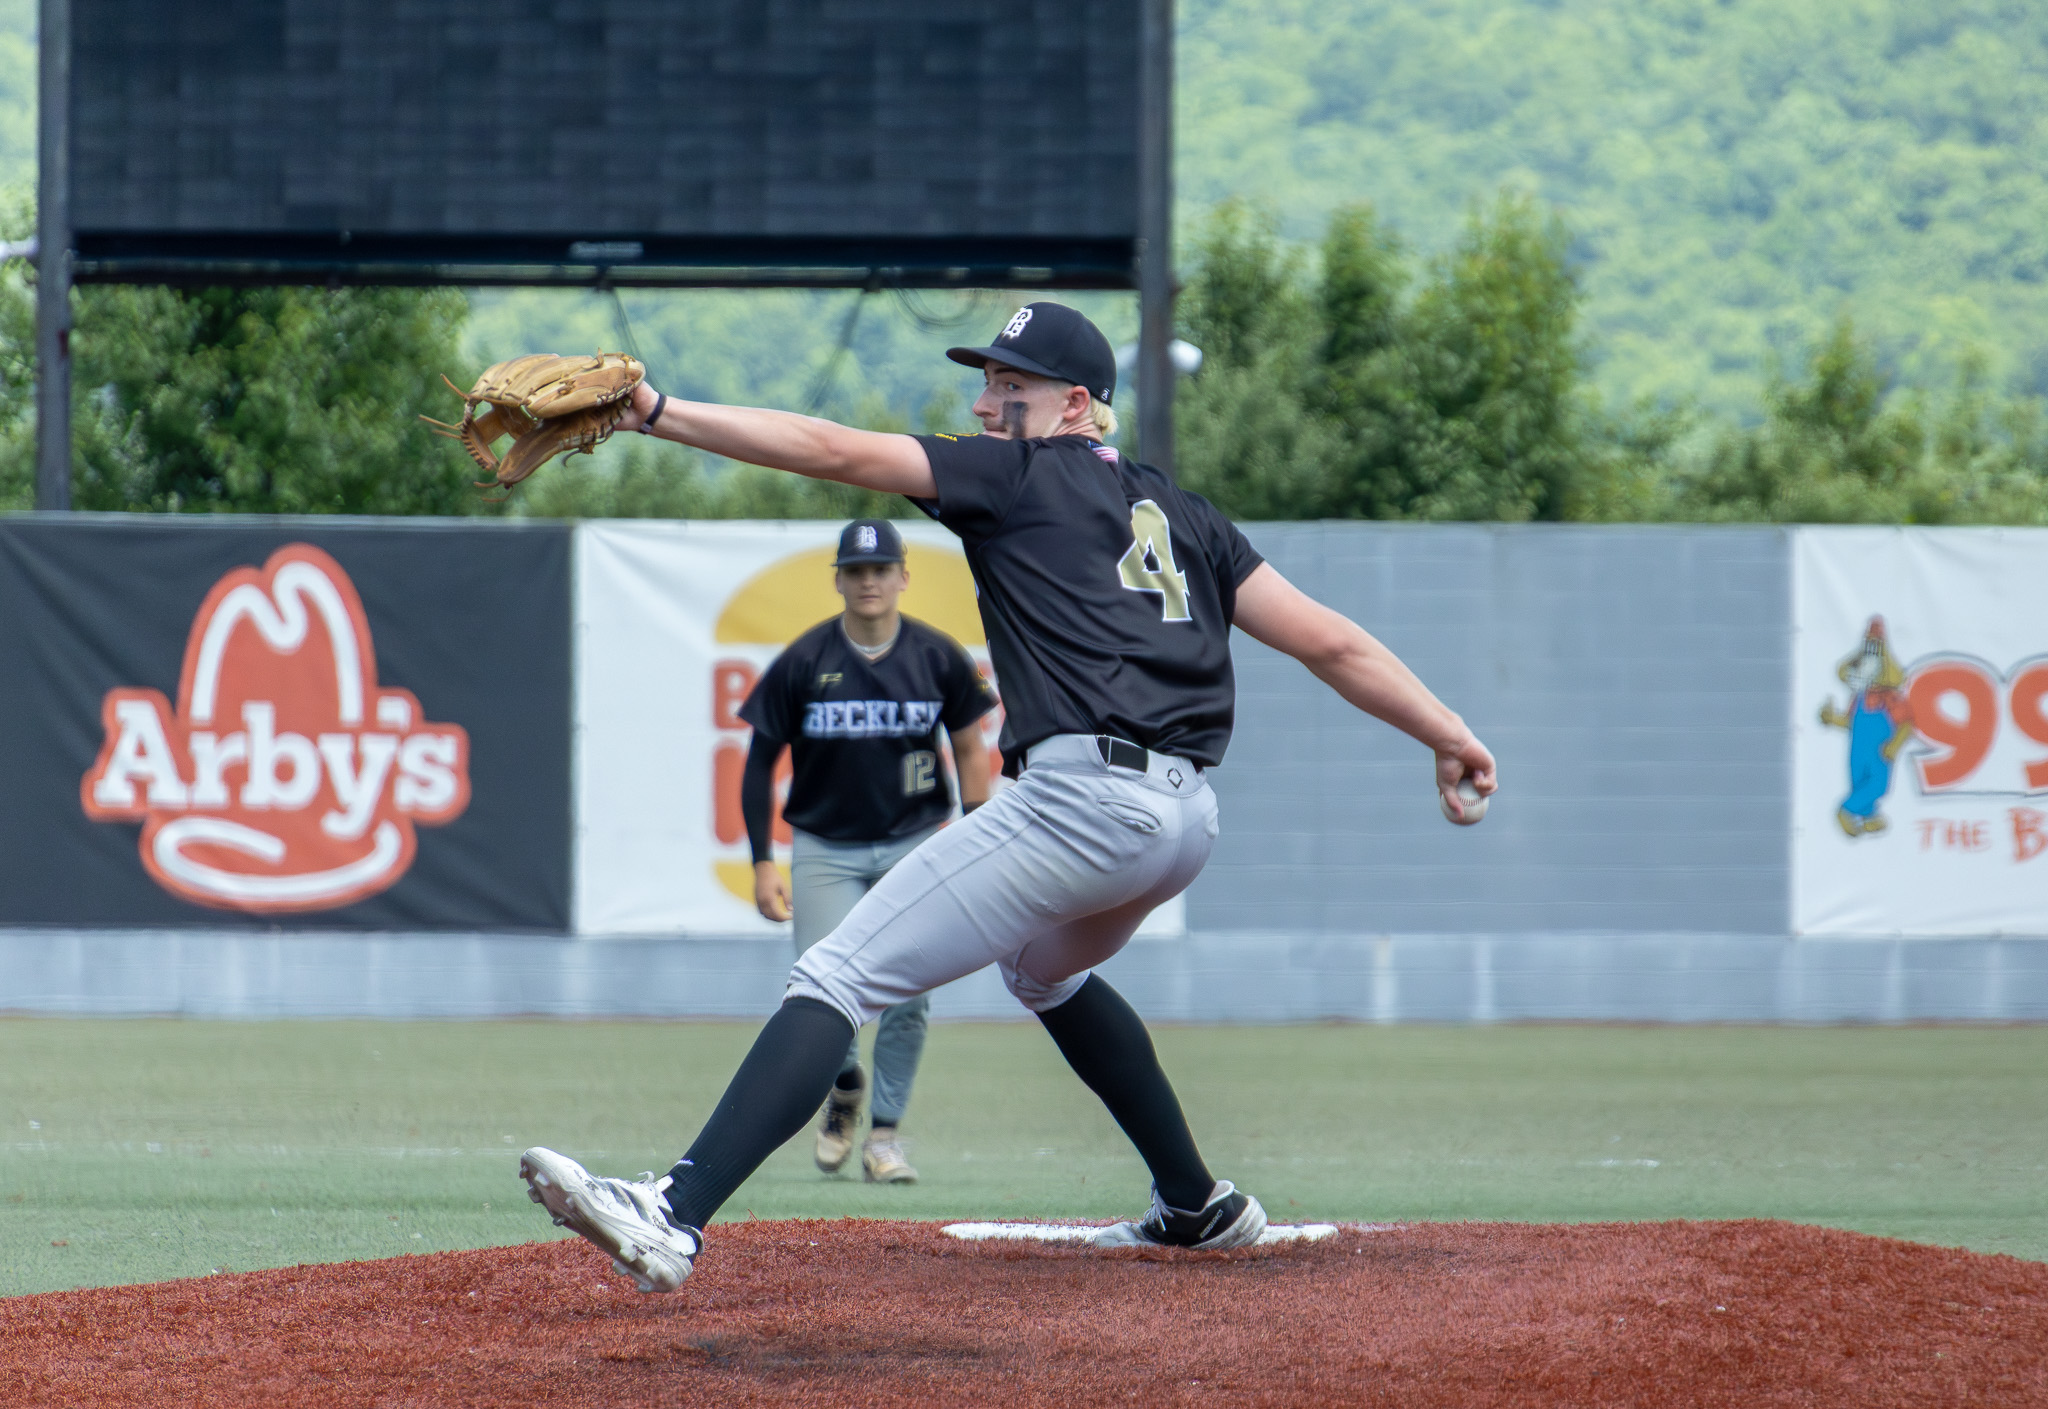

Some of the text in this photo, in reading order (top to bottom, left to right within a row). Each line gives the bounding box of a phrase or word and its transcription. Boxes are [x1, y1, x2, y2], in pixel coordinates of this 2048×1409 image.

[1001, 307, 1033, 339] B
[1117, 499, 1192, 622] 4
[94, 697, 459, 840] Arby's
[903, 750, 936, 796] 12
[1915, 818, 1992, 850] THE
